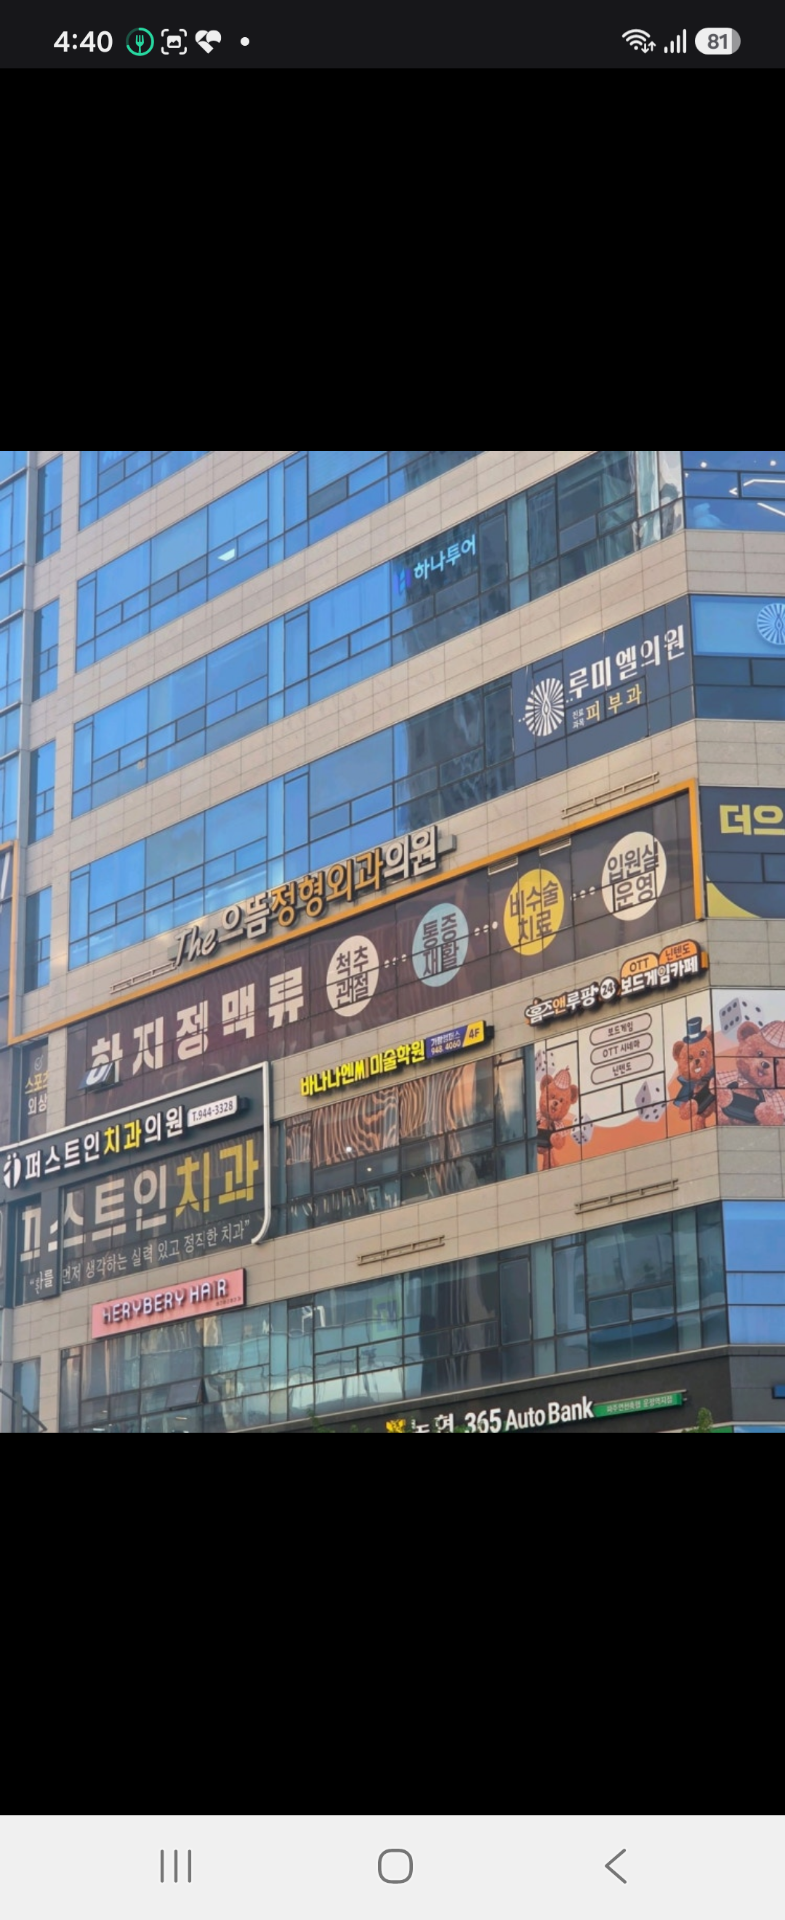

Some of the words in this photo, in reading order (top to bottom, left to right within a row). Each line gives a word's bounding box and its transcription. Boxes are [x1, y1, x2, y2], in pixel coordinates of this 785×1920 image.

[413, 534, 476, 580] 하나투어
[568, 624, 686, 699] 루미엘의원
[586, 683, 642, 721] 피부과
[719, 804, 785, 835] 더으
[607, 841, 659, 882] 입원실
[175, 925, 218, 967] The
[219, 825, 437, 942] 으뜸정형외과의원
[508, 880, 560, 916] 비수술
[615, 873, 656, 912] 운영
[422, 912, 458, 949] 통증
[518, 910, 554, 943] 치료
[336, 945, 369, 976] 척추
[423, 941, 459, 976] 재활
[629, 957, 651, 973] OTT
[665, 944, 692, 962] 닌텐도
[336, 971, 369, 1007] 관절
[602, 981, 615, 995] 24
[620, 955, 699, 996] 보드게임카페
[87, 966, 305, 1084] 하지정맥류
[468, 1028, 480, 1040] 4F
[607, 1021, 634, 1037] 보드게임
[370, 1039, 425, 1075] 미술학원
[602, 1045, 619, 1058] OTT
[620, 1039, 641, 1053] 시네마
[612, 1061, 632, 1077] 닌텐도
[27, 1093, 47, 1115] 외상
[25, 1105, 184, 1181] 퍼스트인치과의원
[191, 1100, 234, 1122] T.944-3328
[62, 1263, 81, 1285] 먼저
[86, 1252, 128, 1279] 생각하는
[131, 1245, 153, 1267] 실력
[157, 1239, 180, 1261] 있고
[184, 1228, 218, 1254] 정직한
[464, 1407, 502, 1433] 365
[505, 1407, 545, 1432] Auto
[548, 1396, 594, 1425] Bank
